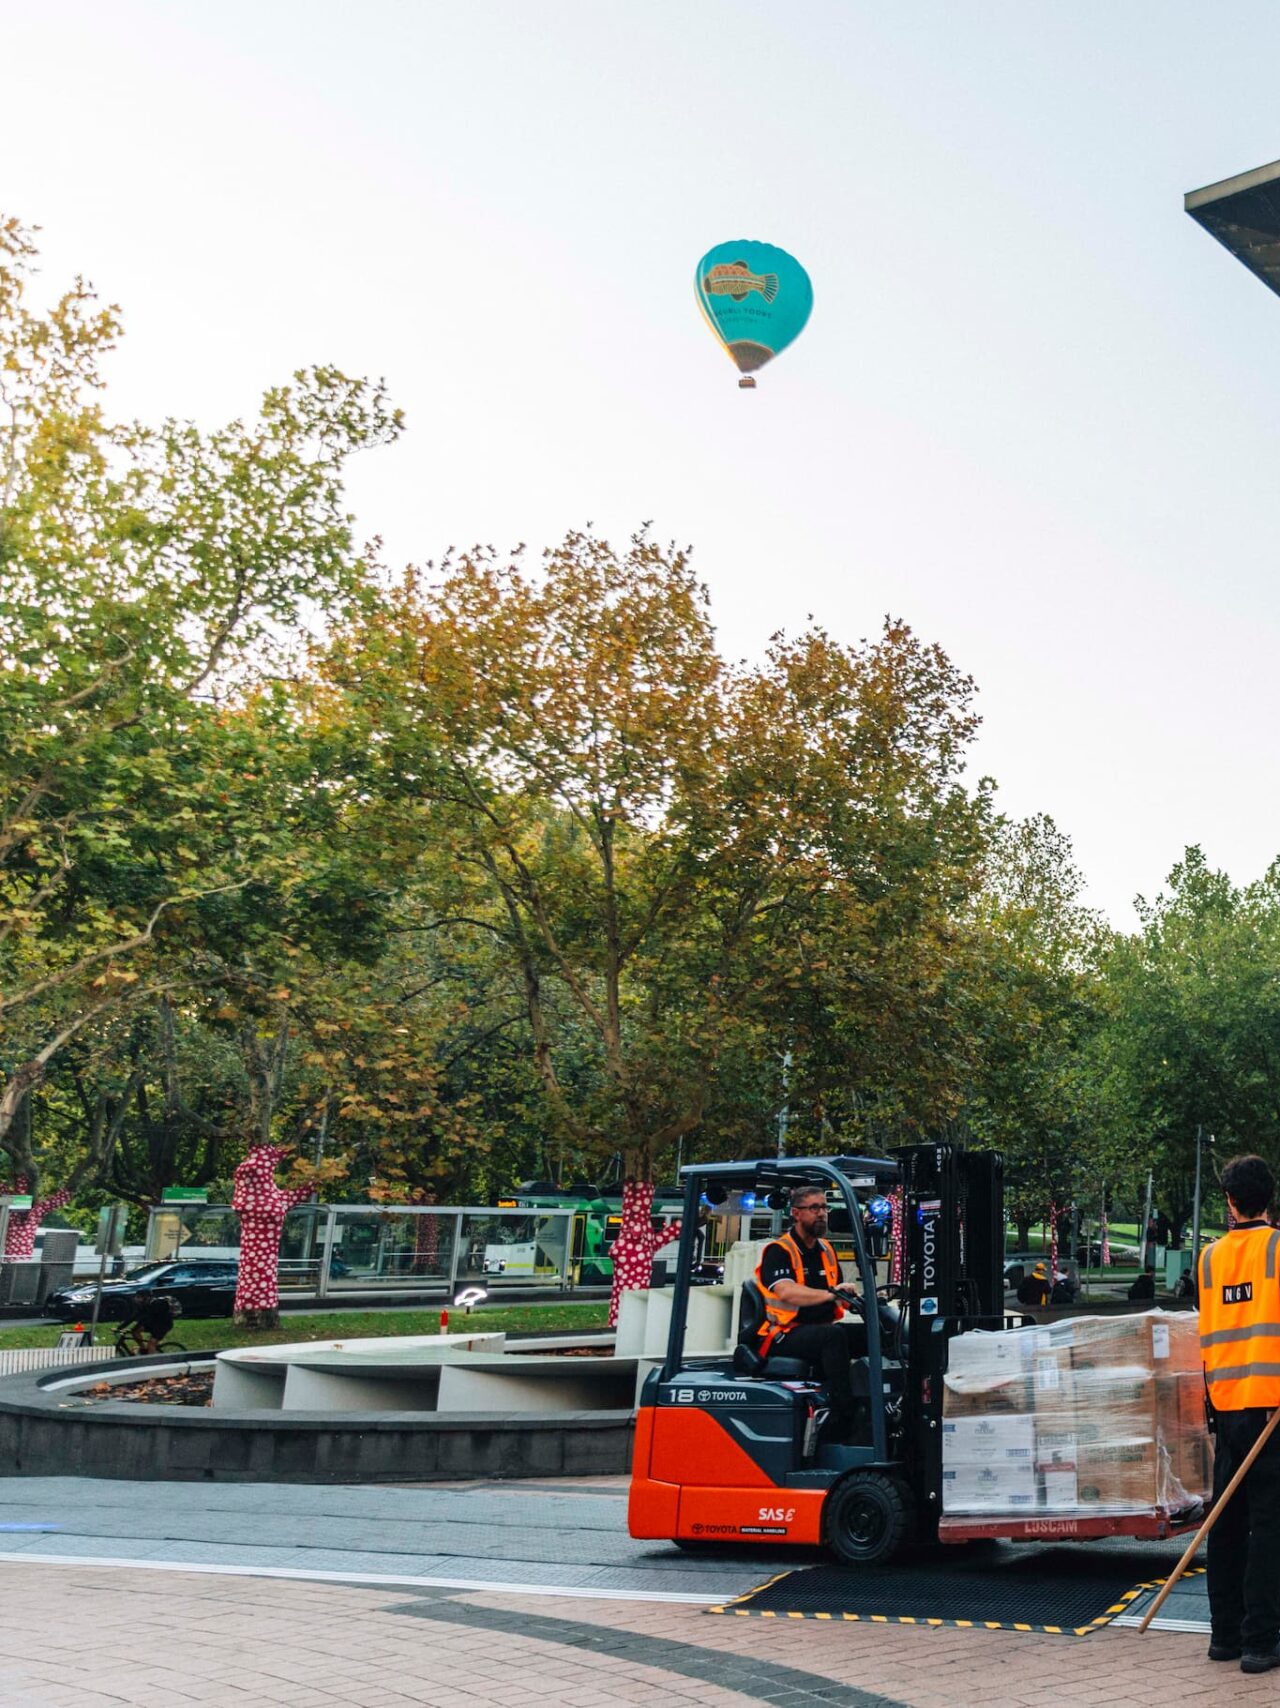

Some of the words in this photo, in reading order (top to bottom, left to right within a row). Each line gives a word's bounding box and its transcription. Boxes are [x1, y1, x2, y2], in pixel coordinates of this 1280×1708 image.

[923, 1219, 935, 1290] TOYOTA
[1225, 1285, 1251, 1302] NGV
[669, 1389, 695, 1403] 18
[711, 1391, 748, 1401] TOYOTA
[705, 1525, 737, 1533] TOYOTA
